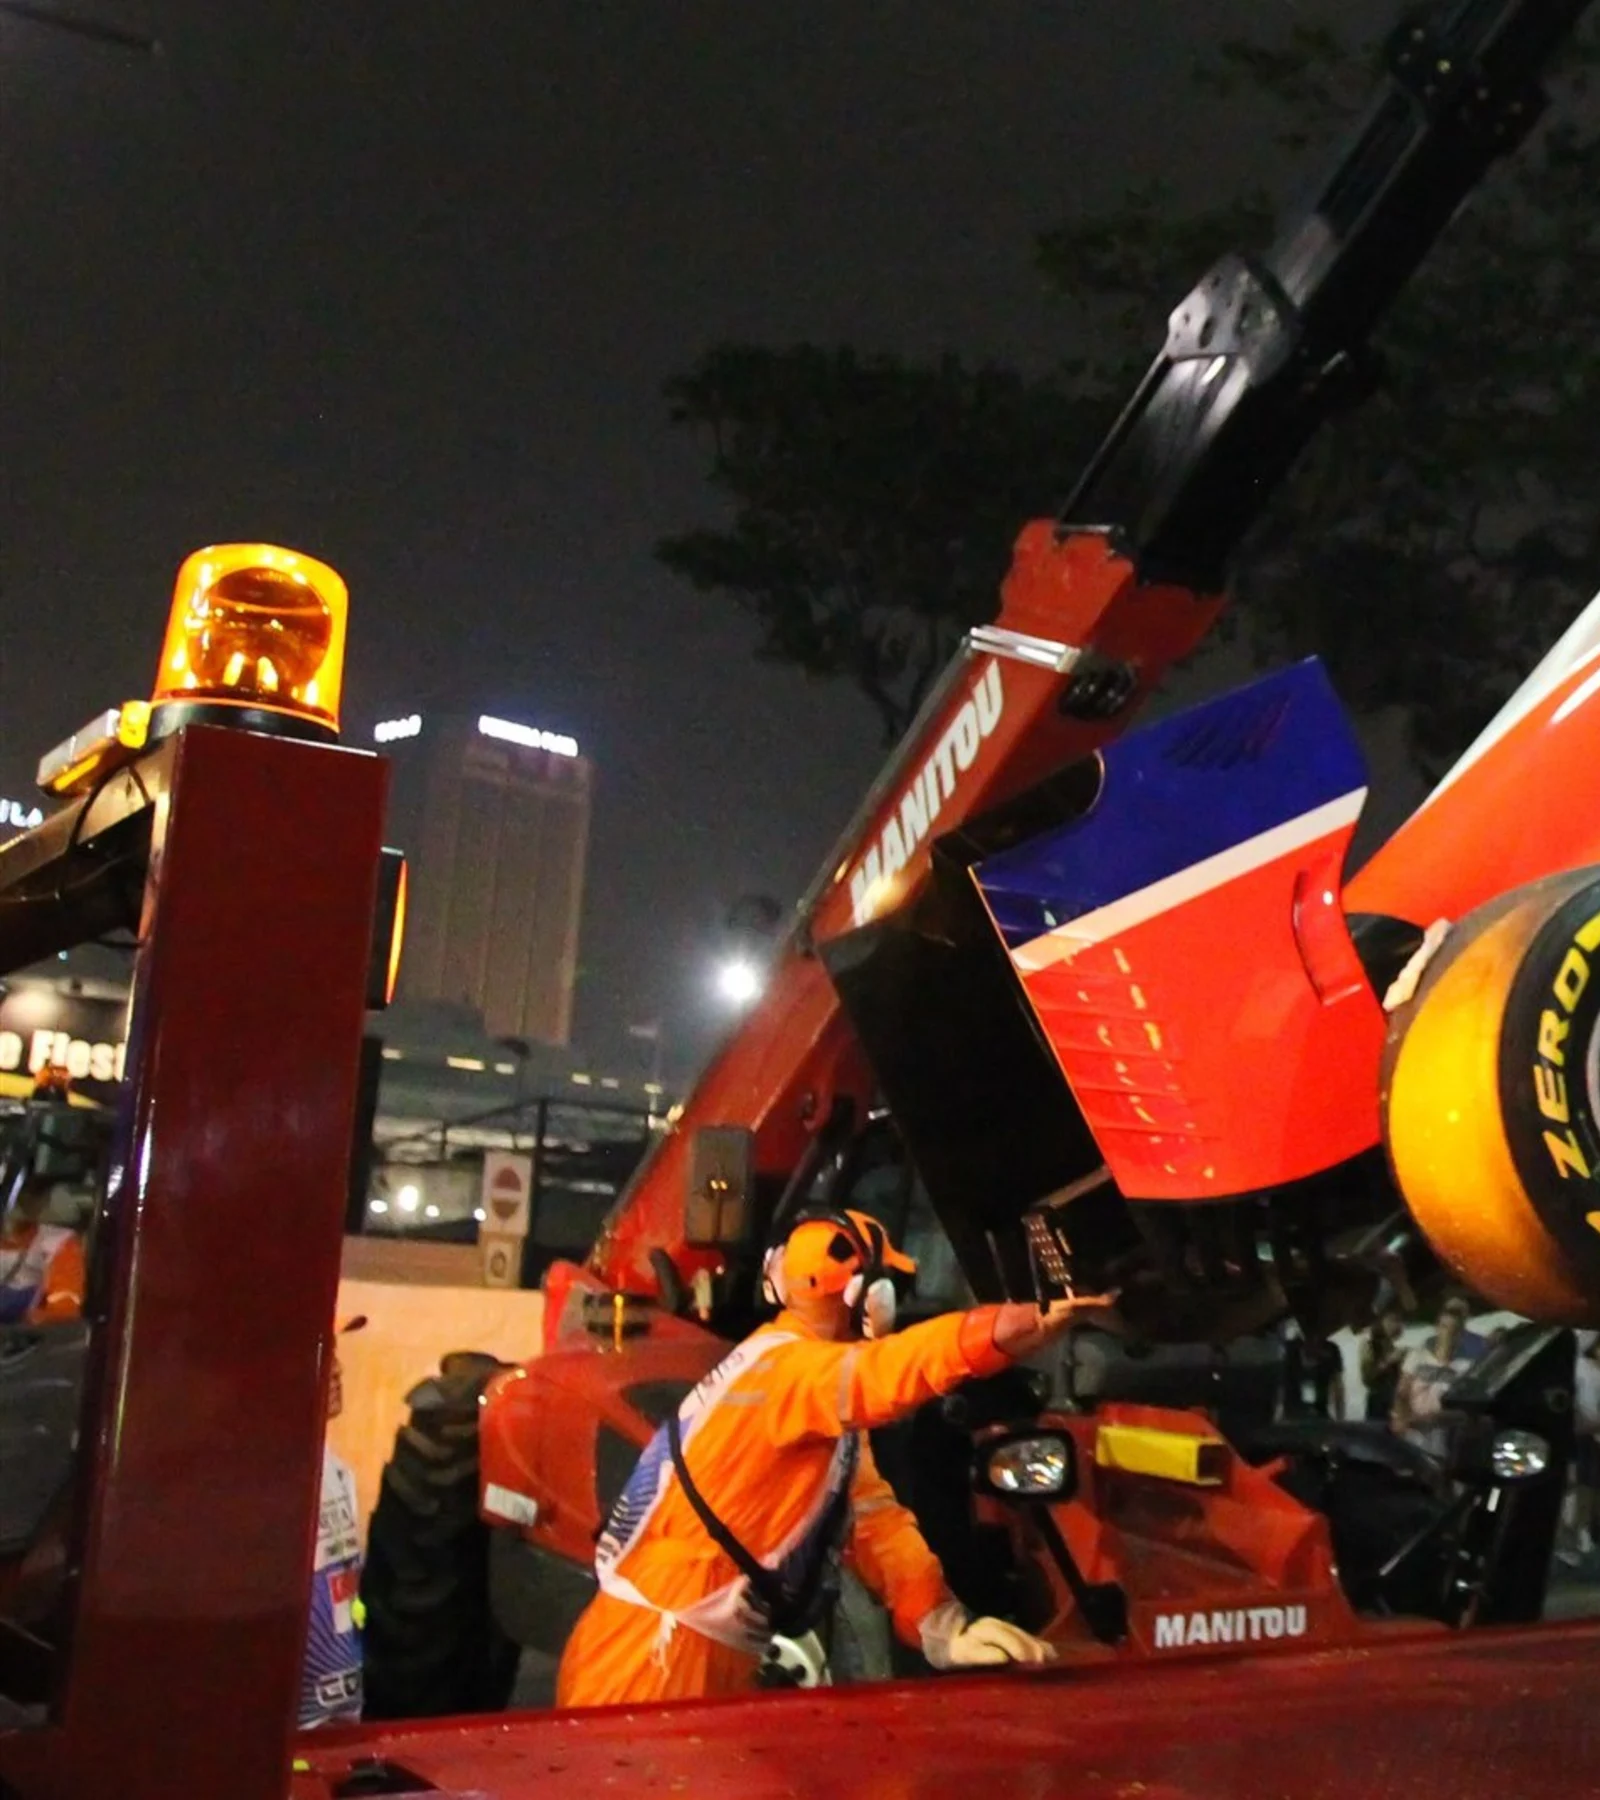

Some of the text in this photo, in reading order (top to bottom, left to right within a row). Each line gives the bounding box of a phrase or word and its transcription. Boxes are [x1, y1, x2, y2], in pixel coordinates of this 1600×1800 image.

[850, 658, 1004, 928] MANITOU
[1533, 947, 1591, 1180] ZERO
[1154, 1603, 1307, 1649] MANITOU
